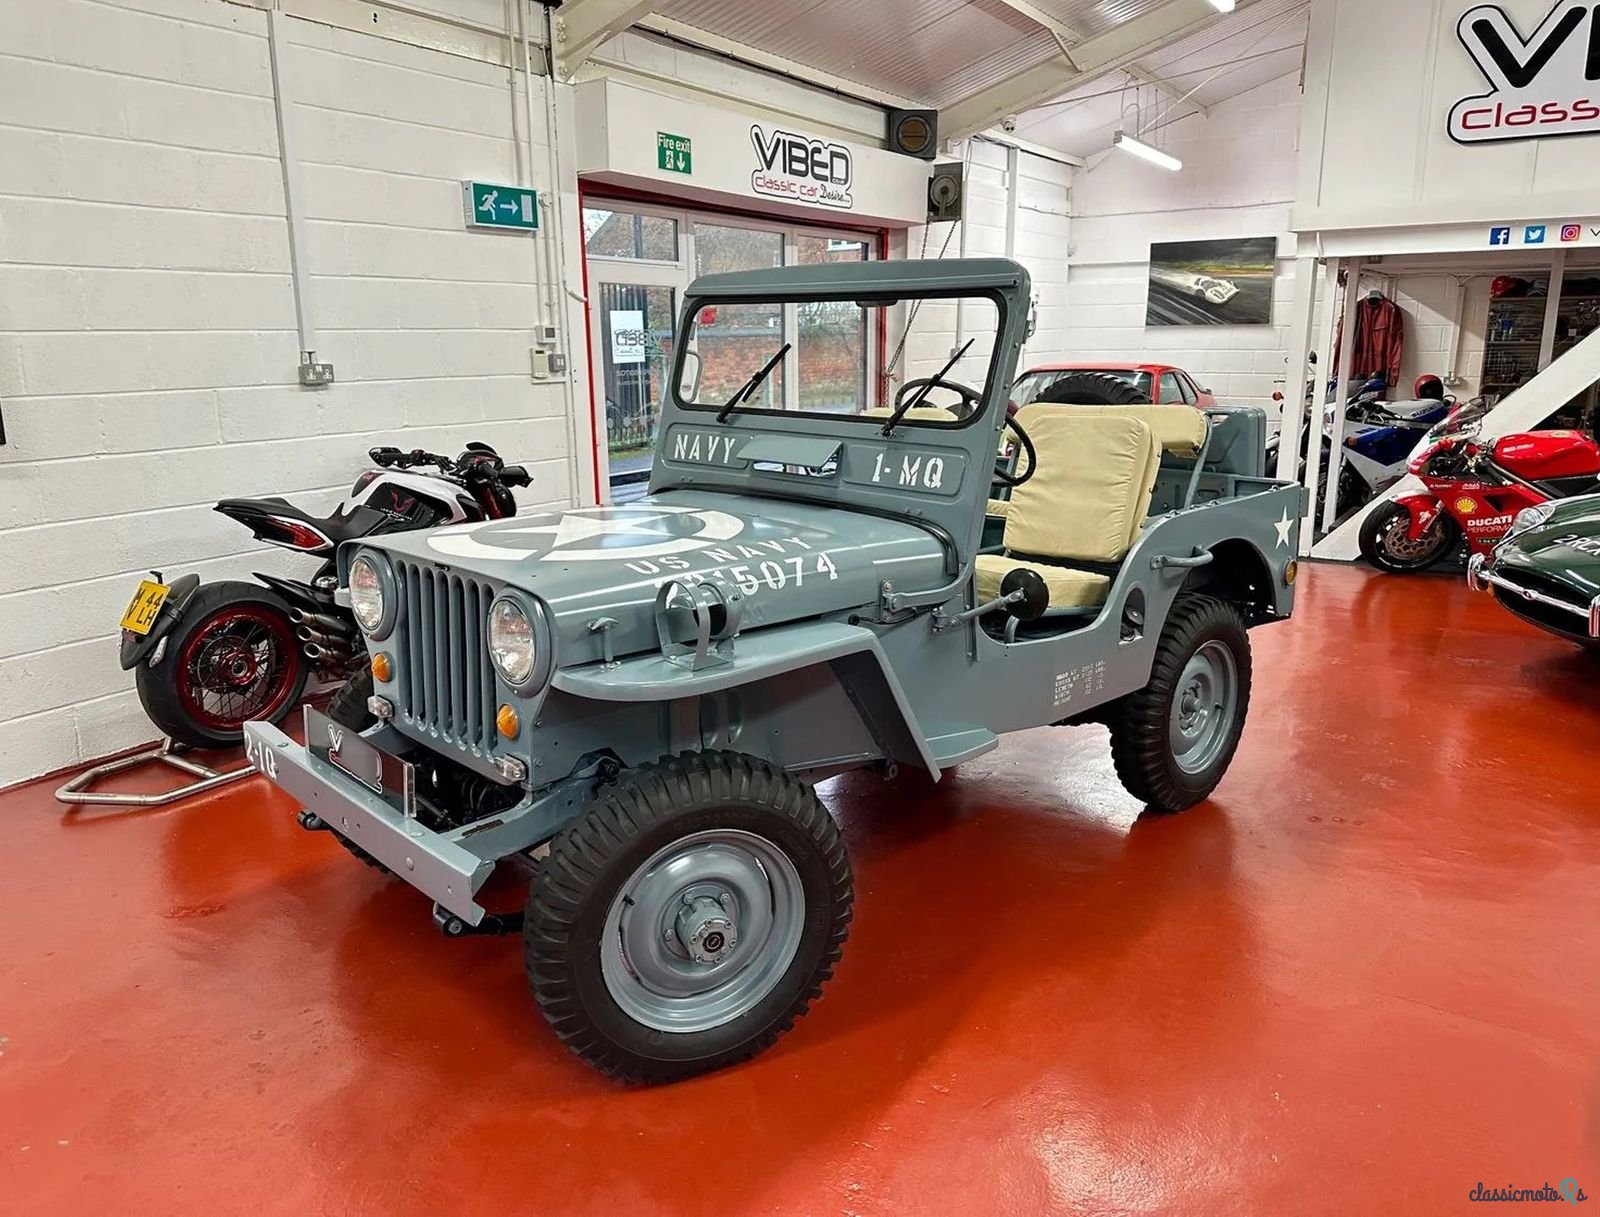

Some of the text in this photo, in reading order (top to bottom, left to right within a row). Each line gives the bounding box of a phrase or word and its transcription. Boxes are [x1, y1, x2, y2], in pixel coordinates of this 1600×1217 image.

[658, 133, 691, 153] Fire exit
[754, 132, 849, 185] VIBED
[800, 185, 818, 197] car
[673, 434, 736, 464] NAVY
[871, 453, 944, 489] 1-MQ
[1467, 515, 1513, 527] DUCATI
[624, 537, 812, 575] US NAVY
